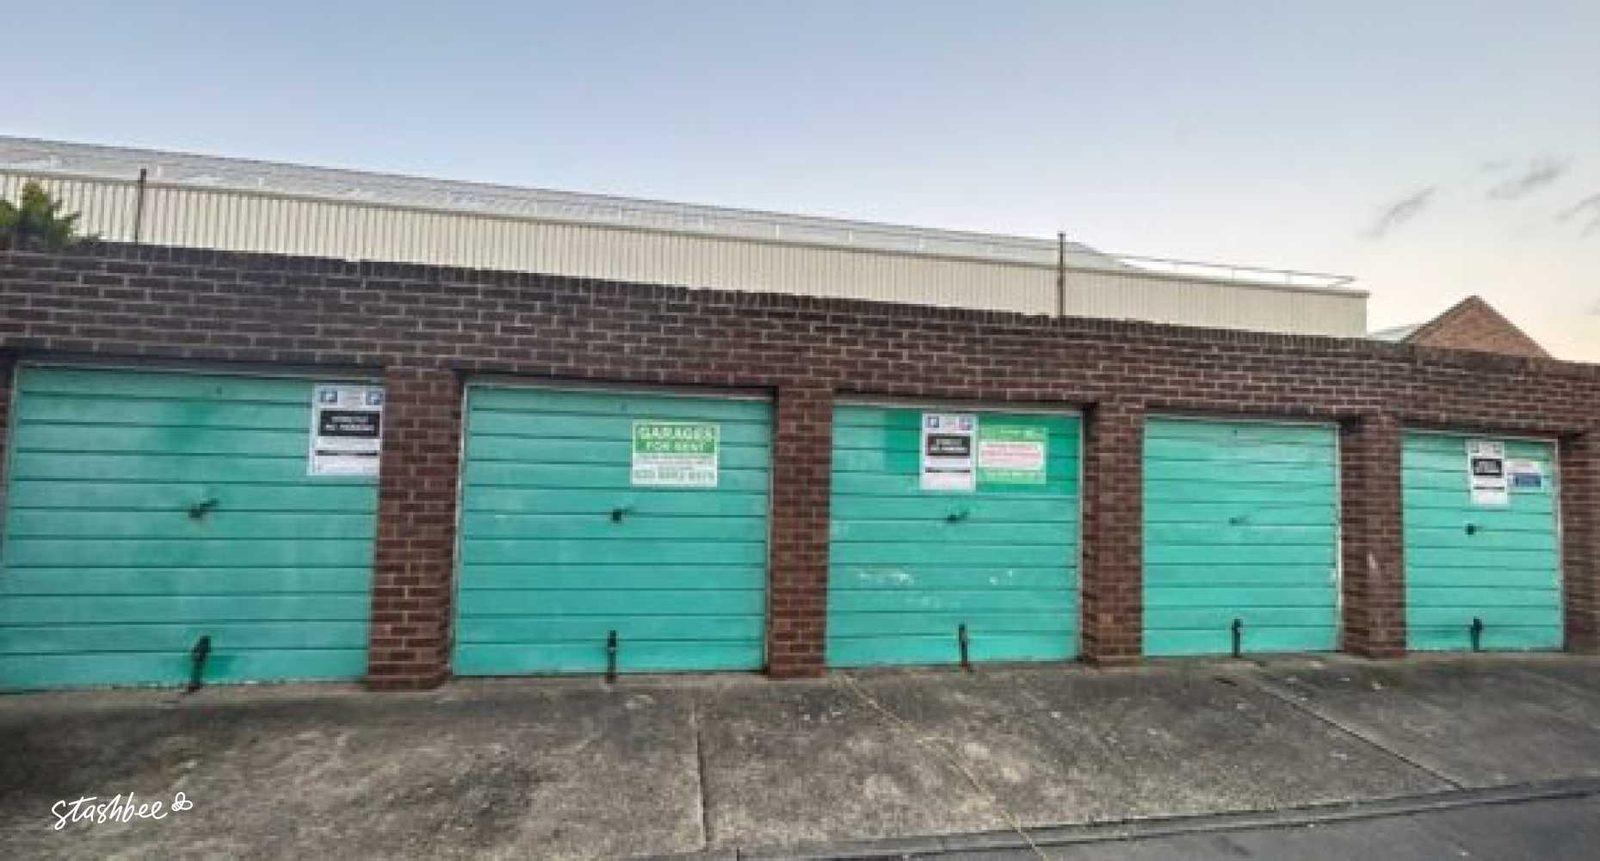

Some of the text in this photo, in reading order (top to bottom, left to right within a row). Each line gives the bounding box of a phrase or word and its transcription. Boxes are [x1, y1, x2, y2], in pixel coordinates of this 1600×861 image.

[637, 426, 715, 441] GARAGES
[646, 441, 706, 453] FOR RENT
